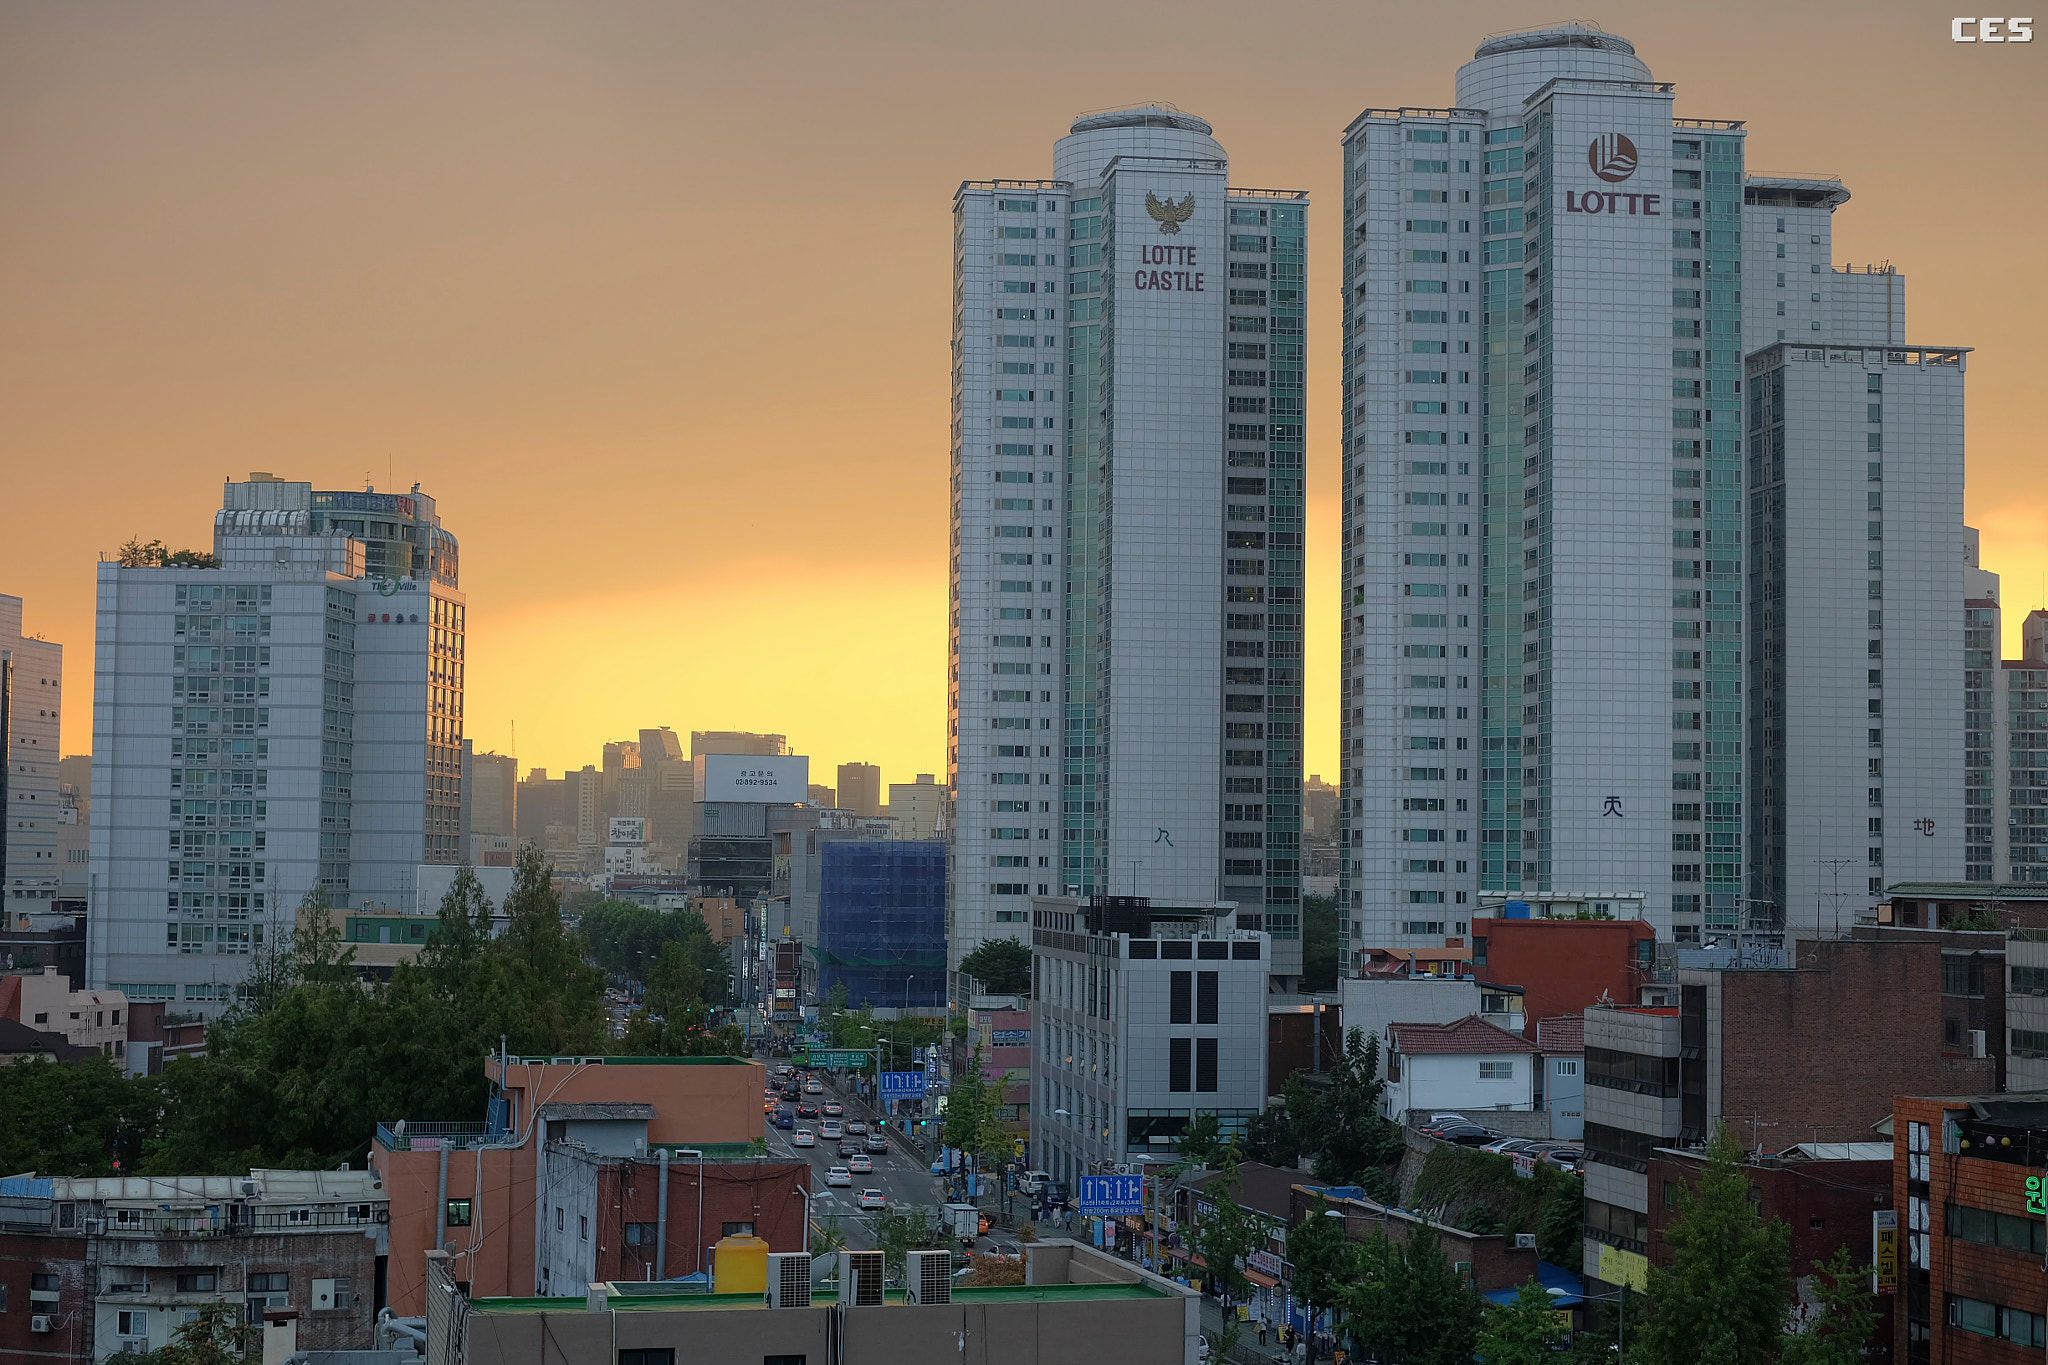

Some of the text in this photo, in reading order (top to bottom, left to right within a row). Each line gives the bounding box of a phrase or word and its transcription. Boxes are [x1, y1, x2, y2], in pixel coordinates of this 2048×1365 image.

[1567, 190, 1660, 215] LOTTE
[1142, 245, 1196, 266] LOTTE
[1135, 270, 1204, 292] CASTLE
[399, 581, 417, 591] Ville
[1603, 796, 1623, 817] 天
[611, 827, 639, 840] 참이슬
[1913, 817, 1935, 837] 地
[1880, 1230, 1895, 1275] 패스빌
